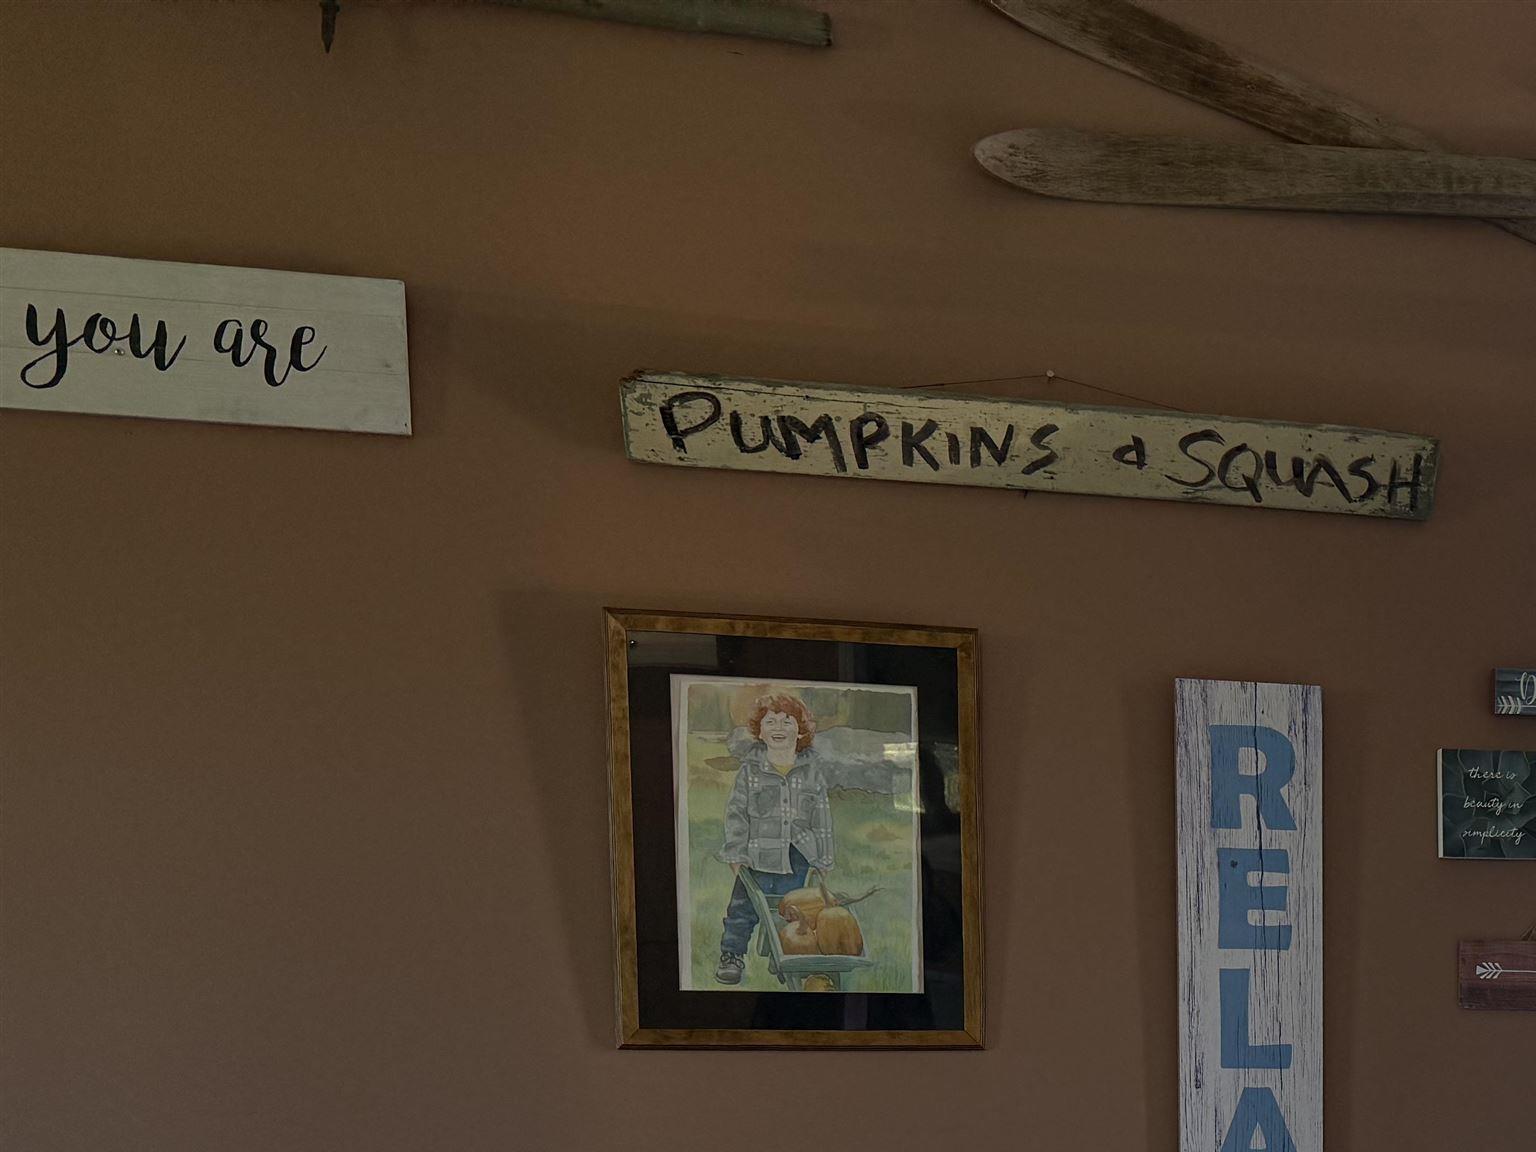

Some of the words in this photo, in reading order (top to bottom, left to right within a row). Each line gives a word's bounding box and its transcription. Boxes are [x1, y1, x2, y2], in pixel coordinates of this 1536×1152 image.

[20, 302, 187, 389] you
[213, 318, 328, 388] are
[658, 391, 1060, 477] PUMPKINS
[1163, 428, 1426, 516] SQUASH
[1467, 765, 1504, 779] there
[1505, 771, 1518, 780] is
[1463, 795, 1506, 816] beauty
[1507, 801, 1524, 809] in
[1462, 825, 1526, 846] simplicity
